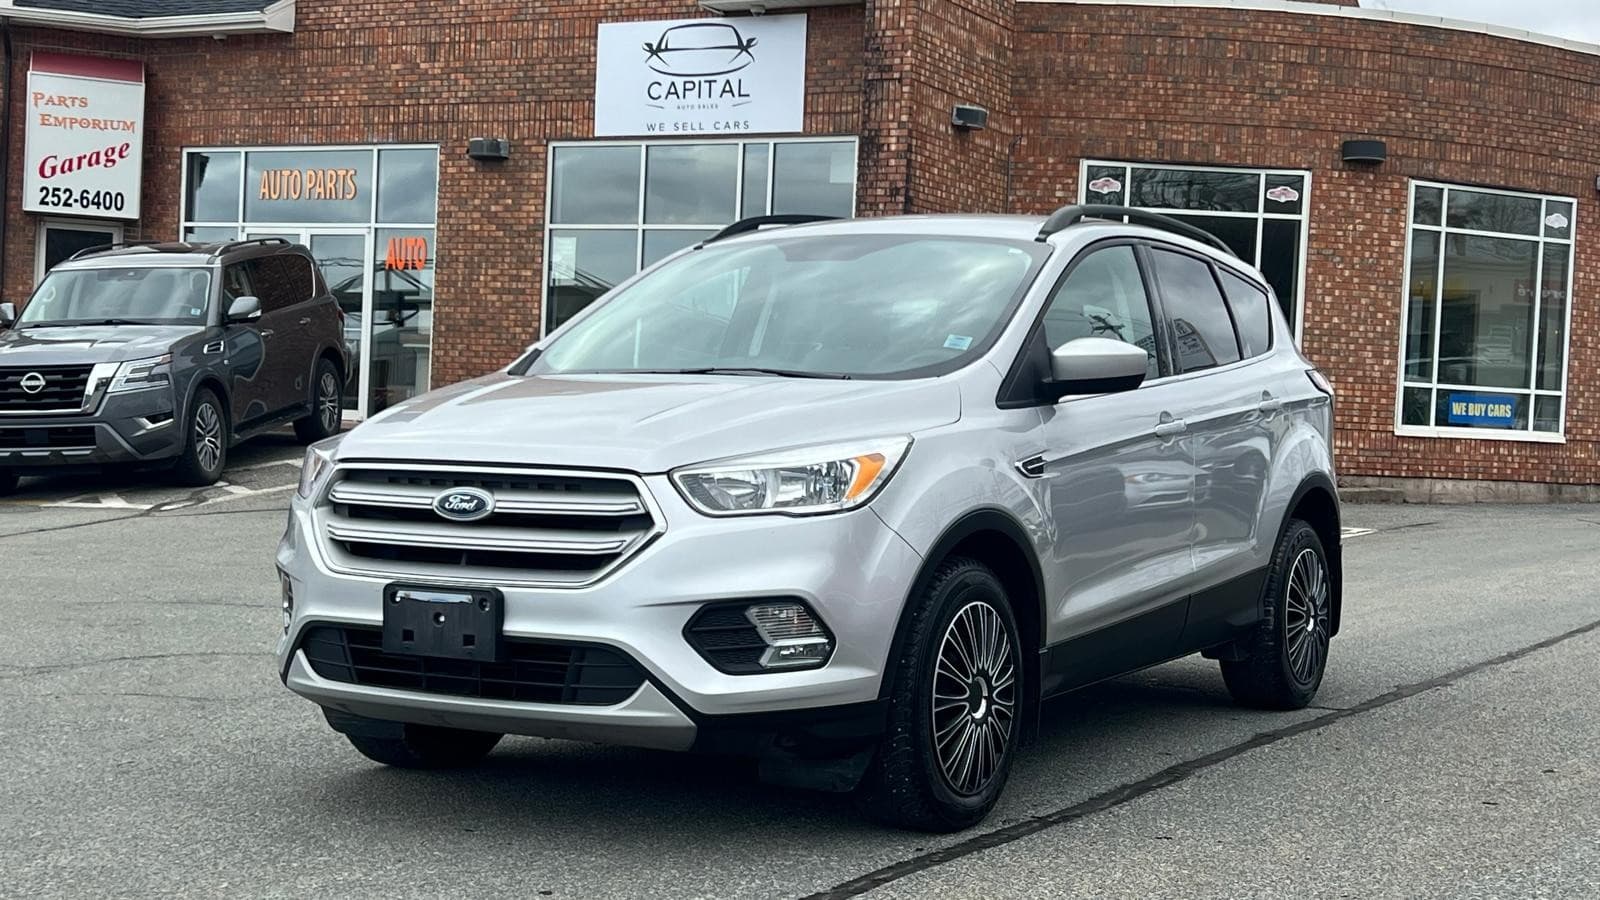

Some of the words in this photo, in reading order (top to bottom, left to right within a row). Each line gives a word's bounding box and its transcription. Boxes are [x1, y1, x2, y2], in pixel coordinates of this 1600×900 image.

[647, 78, 750, 100] CAPITAL
[646, 122, 665, 132] WE
[673, 121, 704, 131] SELL
[713, 120, 750, 130] CARS
[38, 142, 130, 179] Garage
[259, 169, 302, 200] AUTO
[304, 168, 357, 201] PARTS
[38, 186, 125, 211] 252-6400
[385, 236, 428, 271] AUTO
[1452, 401, 1467, 416] WE
[1468, 402, 1487, 417] BUY
[1487, 403, 1512, 418] CARS
[445, 494, 478, 511] Ford
